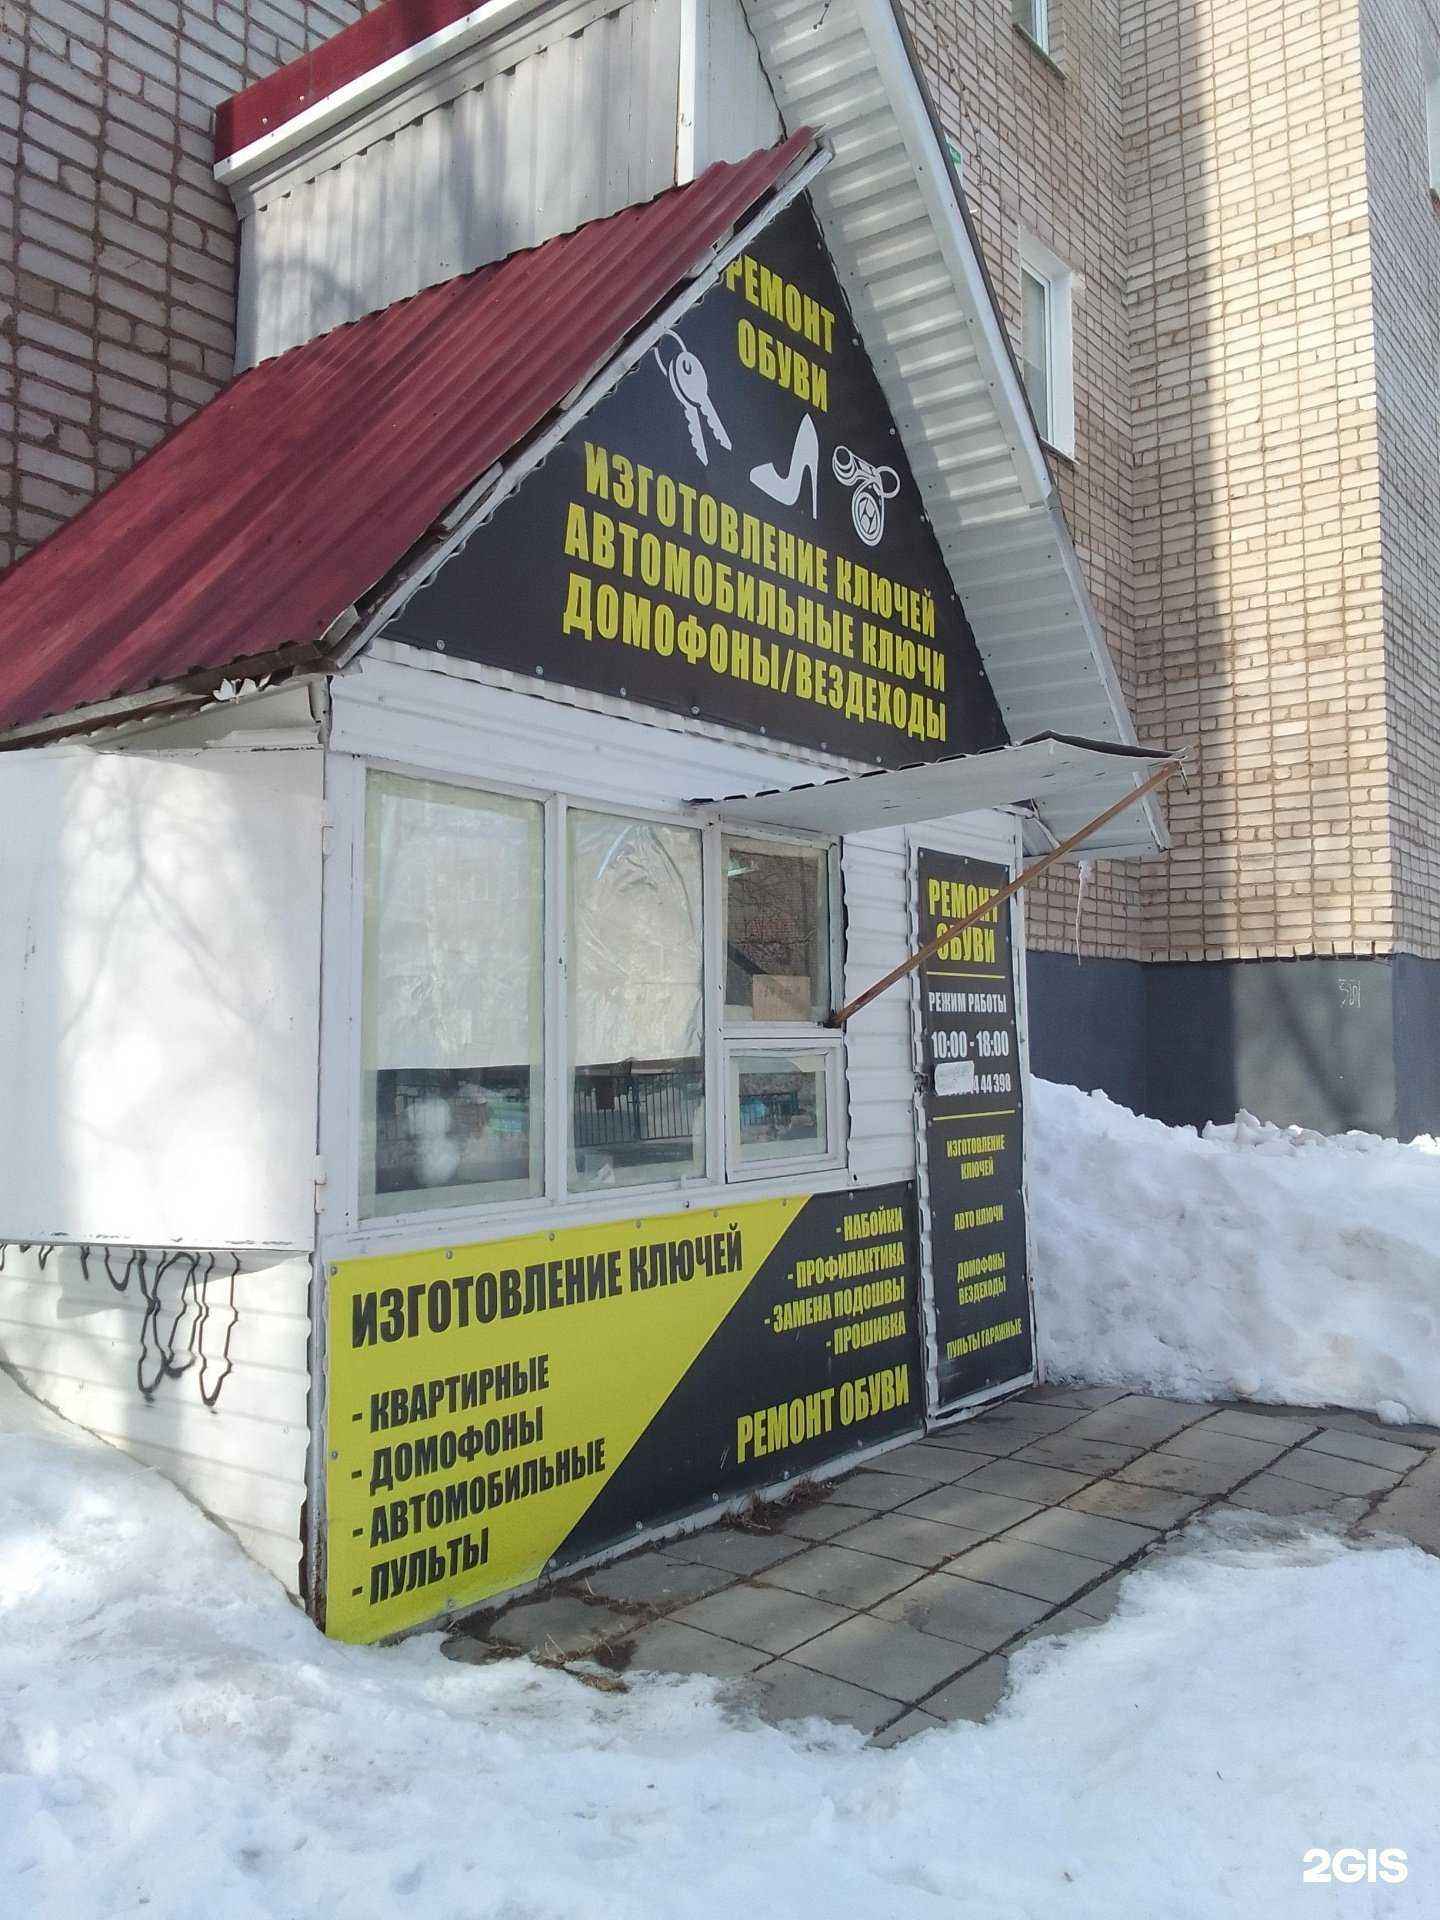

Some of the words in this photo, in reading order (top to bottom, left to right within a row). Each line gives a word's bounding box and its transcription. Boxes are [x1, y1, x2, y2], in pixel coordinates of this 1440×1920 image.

[726, 254, 835, 354] РЕМОНТ
[738, 318, 829, 412] ОБУВИ
[584, 441, 829, 593] ИЗГОТОВЛЕНИЕ
[836, 556, 936, 639] КЛЮЧЕЙ
[563, 503, 854, 657] АВТОМОБИЛЬНЫЕ
[862, 621, 946, 692] КЛЮЧИ
[562, 572, 947, 742] ДОМОФОНЫ/ВЕЗДЕХОДЫ
[928, 992, 967, 1012] РЕЖИМ
[968, 993, 1007, 1013] РАБОТЫ
[931, 1030, 968, 1059] 10:00
[976, 1030, 1010, 1057] 18:00
[946, 1134, 1005, 1158] ИЗГОТОВЛЕНИЕ
[961, 1156, 994, 1180] КЛЮЧЕЙ
[954, 1210, 976, 1231] АВТО
[975, 1204, 1004, 1226] КЛЮЧИ
[351, 1250, 622, 1349] ИЗГОТОВЛЕНИЕ
[629, 1223, 743, 1292] КЛЮЧЕЙ
[834, 1275, 905, 1318] ПОДОШВЫ
[957, 1251, 1005, 1284] ДОМОФОНЫ
[958, 1275, 1006, 1306] ВЕЗДЕХОДЫ
[946, 1331, 980, 1361] ПУЛЬТЫ
[980, 1318, 1022, 1348] ГАРАЖНЫЕ
[369, 1354, 550, 1434] КВАРТИРНЫЕ
[737, 1386, 836, 1465] РЕМОНТ
[839, 1363, 909, 1427] ОБУВИ
[369, 1406, 544, 1497] ДОМОФОНЫ
[369, 1437, 606, 1549] АВТОМОБИЛЬНЫЕ
[368, 1527, 489, 1606] ПУЛЬТЫ
